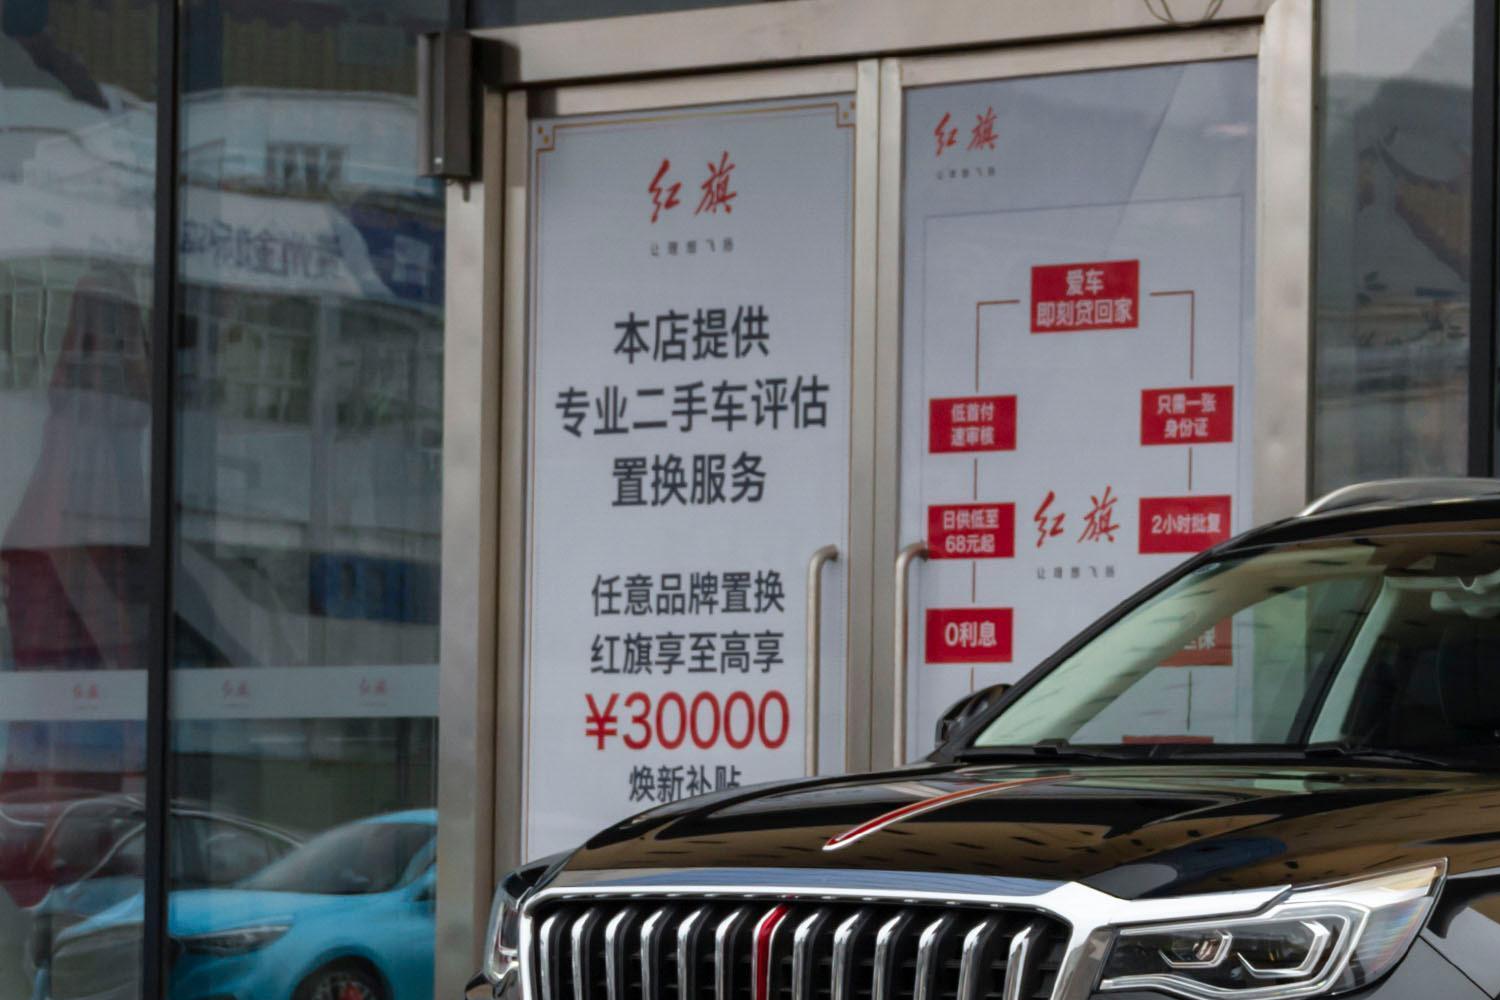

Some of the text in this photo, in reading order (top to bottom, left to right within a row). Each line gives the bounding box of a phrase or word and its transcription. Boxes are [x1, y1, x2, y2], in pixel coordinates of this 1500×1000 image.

[934, 106, 1000, 157] 红旗
[647, 150, 739, 224] 红旗
[1066, 268, 1104, 296] 爱车
[1036, 297, 1133, 327] 即刻贷回家
[613, 304, 770, 364] 本店提供
[555, 375, 830, 438] 专业二手车评估
[1157, 392, 1216, 415] 只需一张
[1164, 417, 1208, 439] 身份证
[611, 451, 766, 507] 置换服务
[942, 508, 1000, 532] 日供低至
[1033, 485, 1120, 548] 红旗
[1152, 513, 1220, 535] 2小时批复
[945, 532, 996, 554] 68元起
[591, 570, 785, 617] 任意品牌置换
[590, 630, 784, 675] 红旗享至高享
[944, 621, 998, 649] 0利息
[585, 690, 790, 751] ¥30000
[629, 764, 741, 802] 焕新补贴
